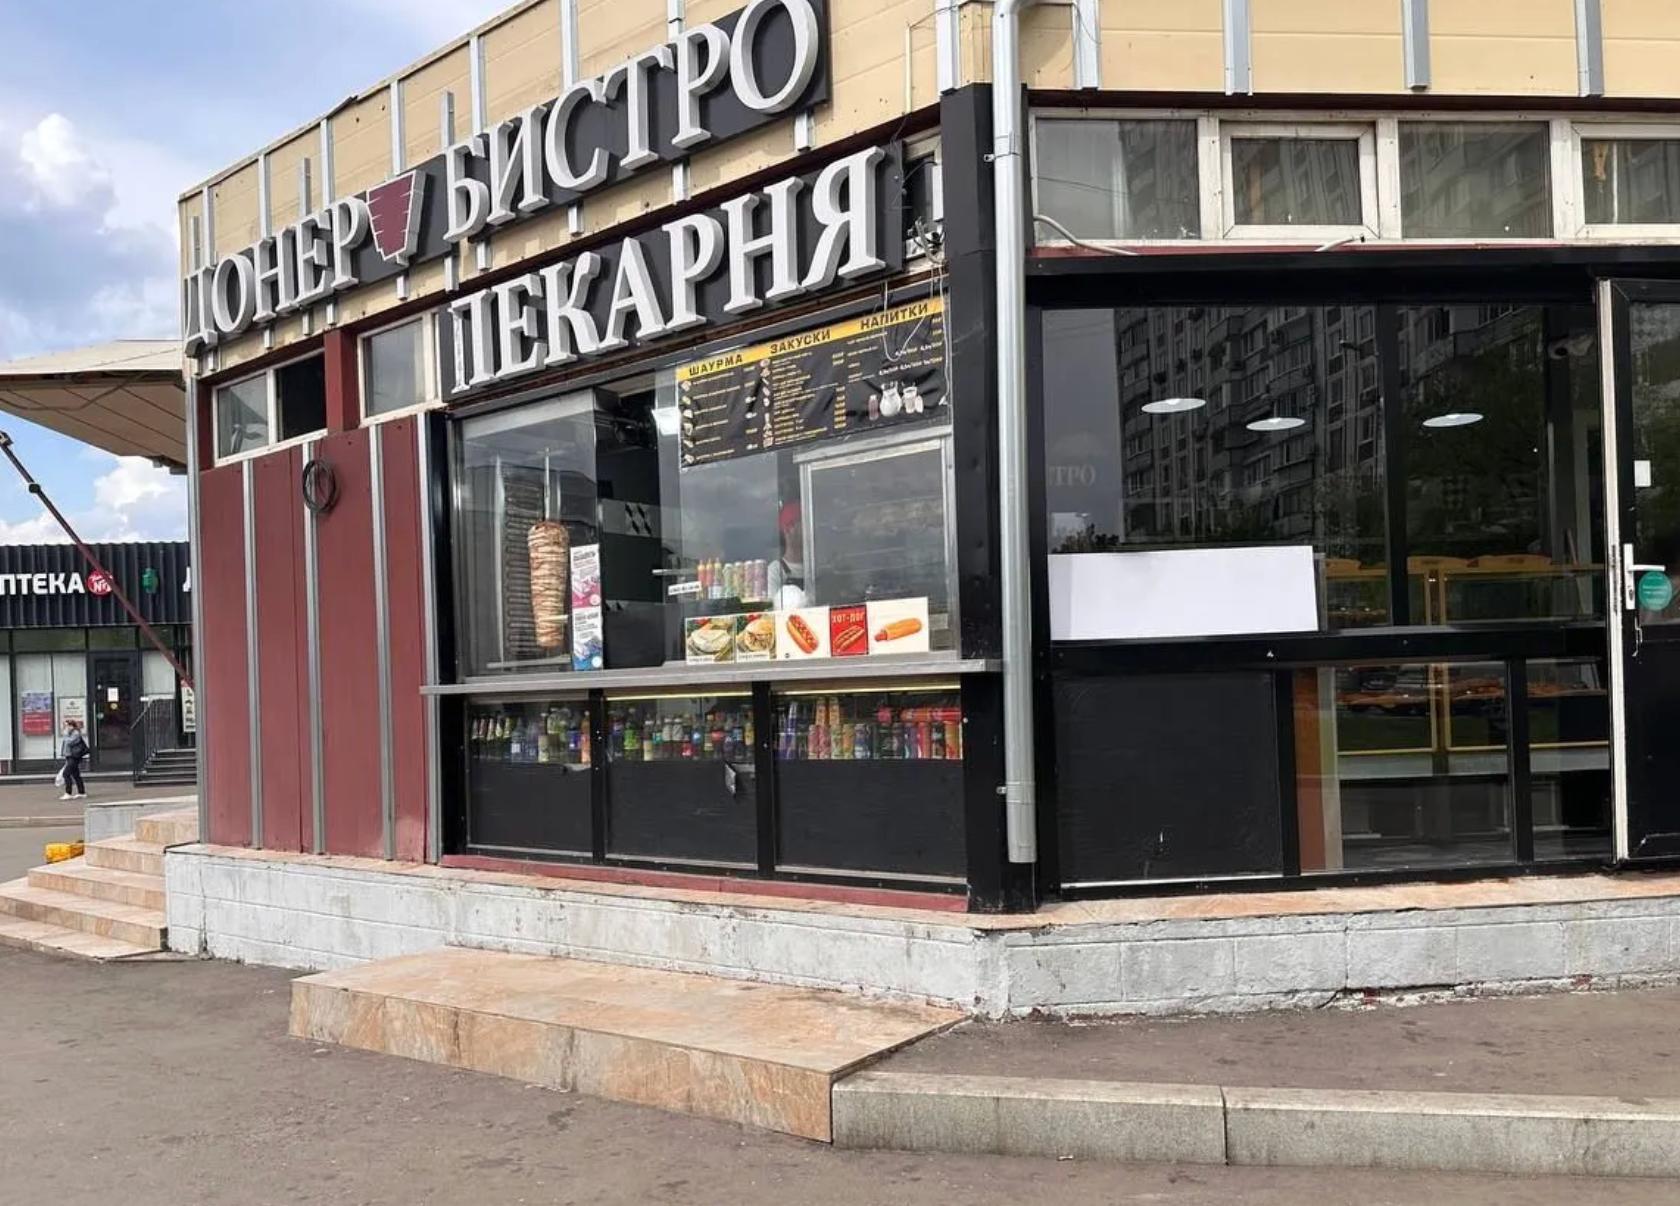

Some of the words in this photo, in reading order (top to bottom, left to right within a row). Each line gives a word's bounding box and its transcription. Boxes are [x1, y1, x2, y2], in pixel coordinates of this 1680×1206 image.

[184, 196, 368, 358] ДОНЕР
[443, 0, 821, 241] БИСТРО
[449, 146, 887, 394] ПЕКАРНЯ
[860, 303, 929, 330] НАПИТКИ
[769, 329, 832, 355] ЗАКУСКИ
[688, 353, 744, 376] ШАУРМА
